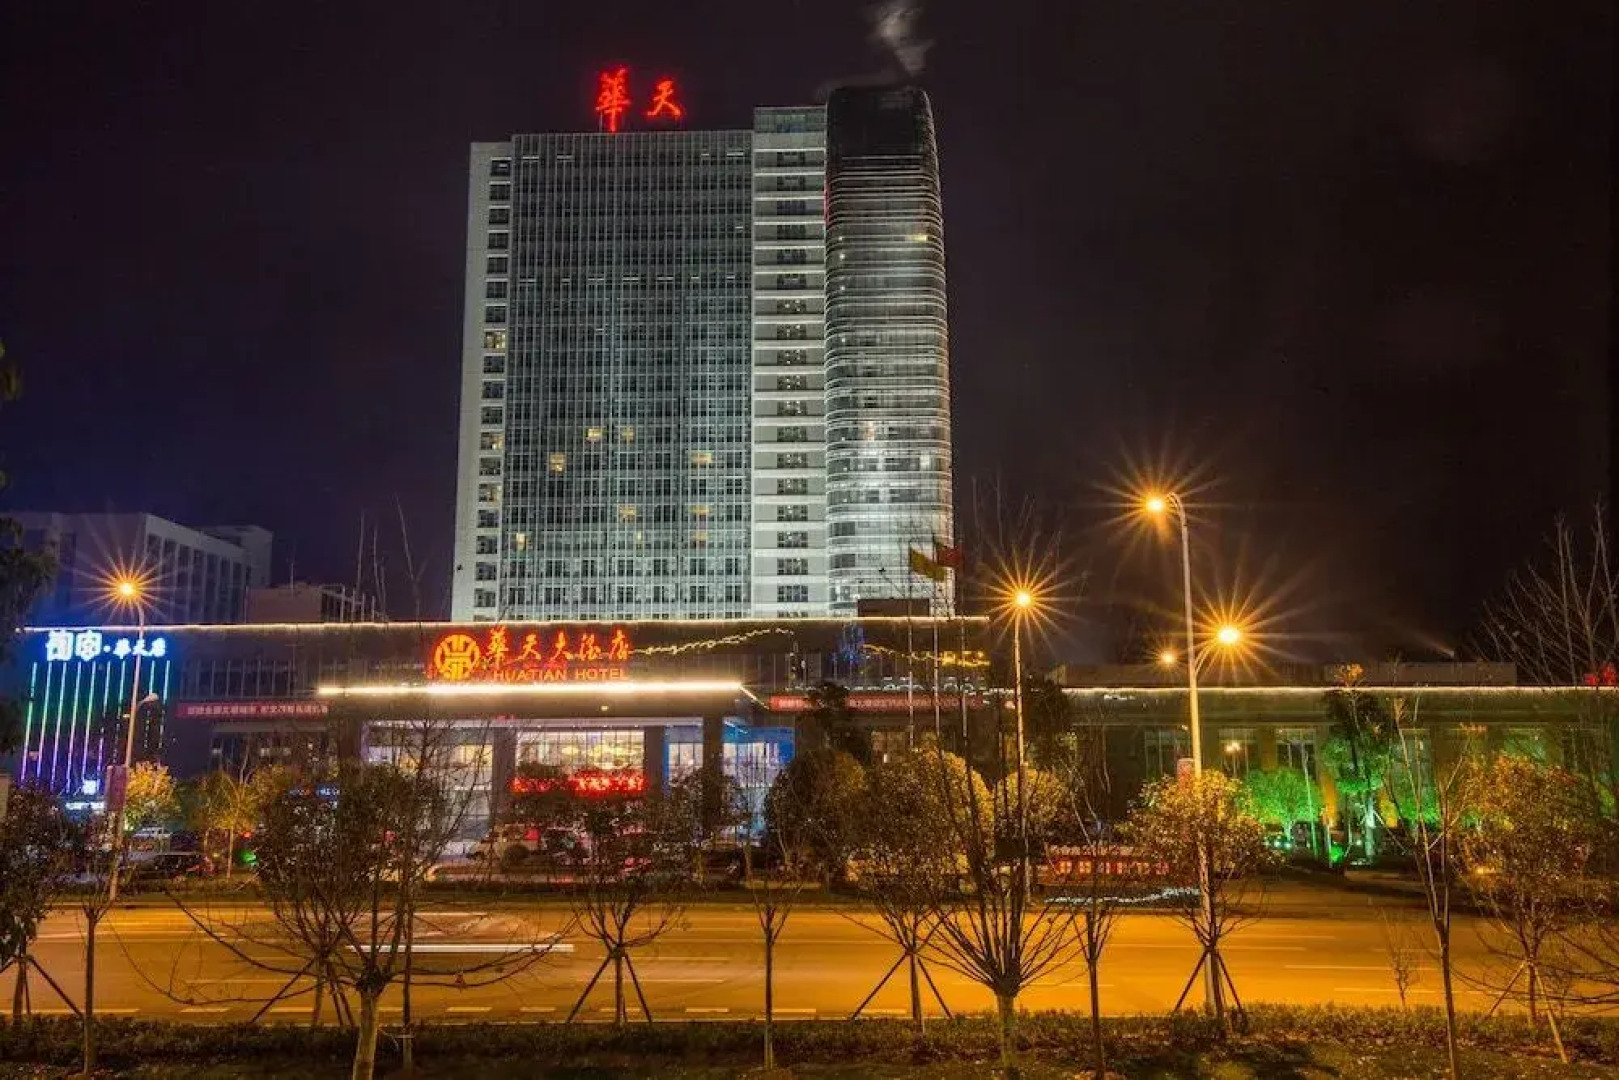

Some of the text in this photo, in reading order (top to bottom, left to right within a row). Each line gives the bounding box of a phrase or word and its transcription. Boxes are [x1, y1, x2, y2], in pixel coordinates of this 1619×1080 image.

[595, 67, 682, 132] 華天
[493, 668, 629, 681] HUATIAN HOTEL
